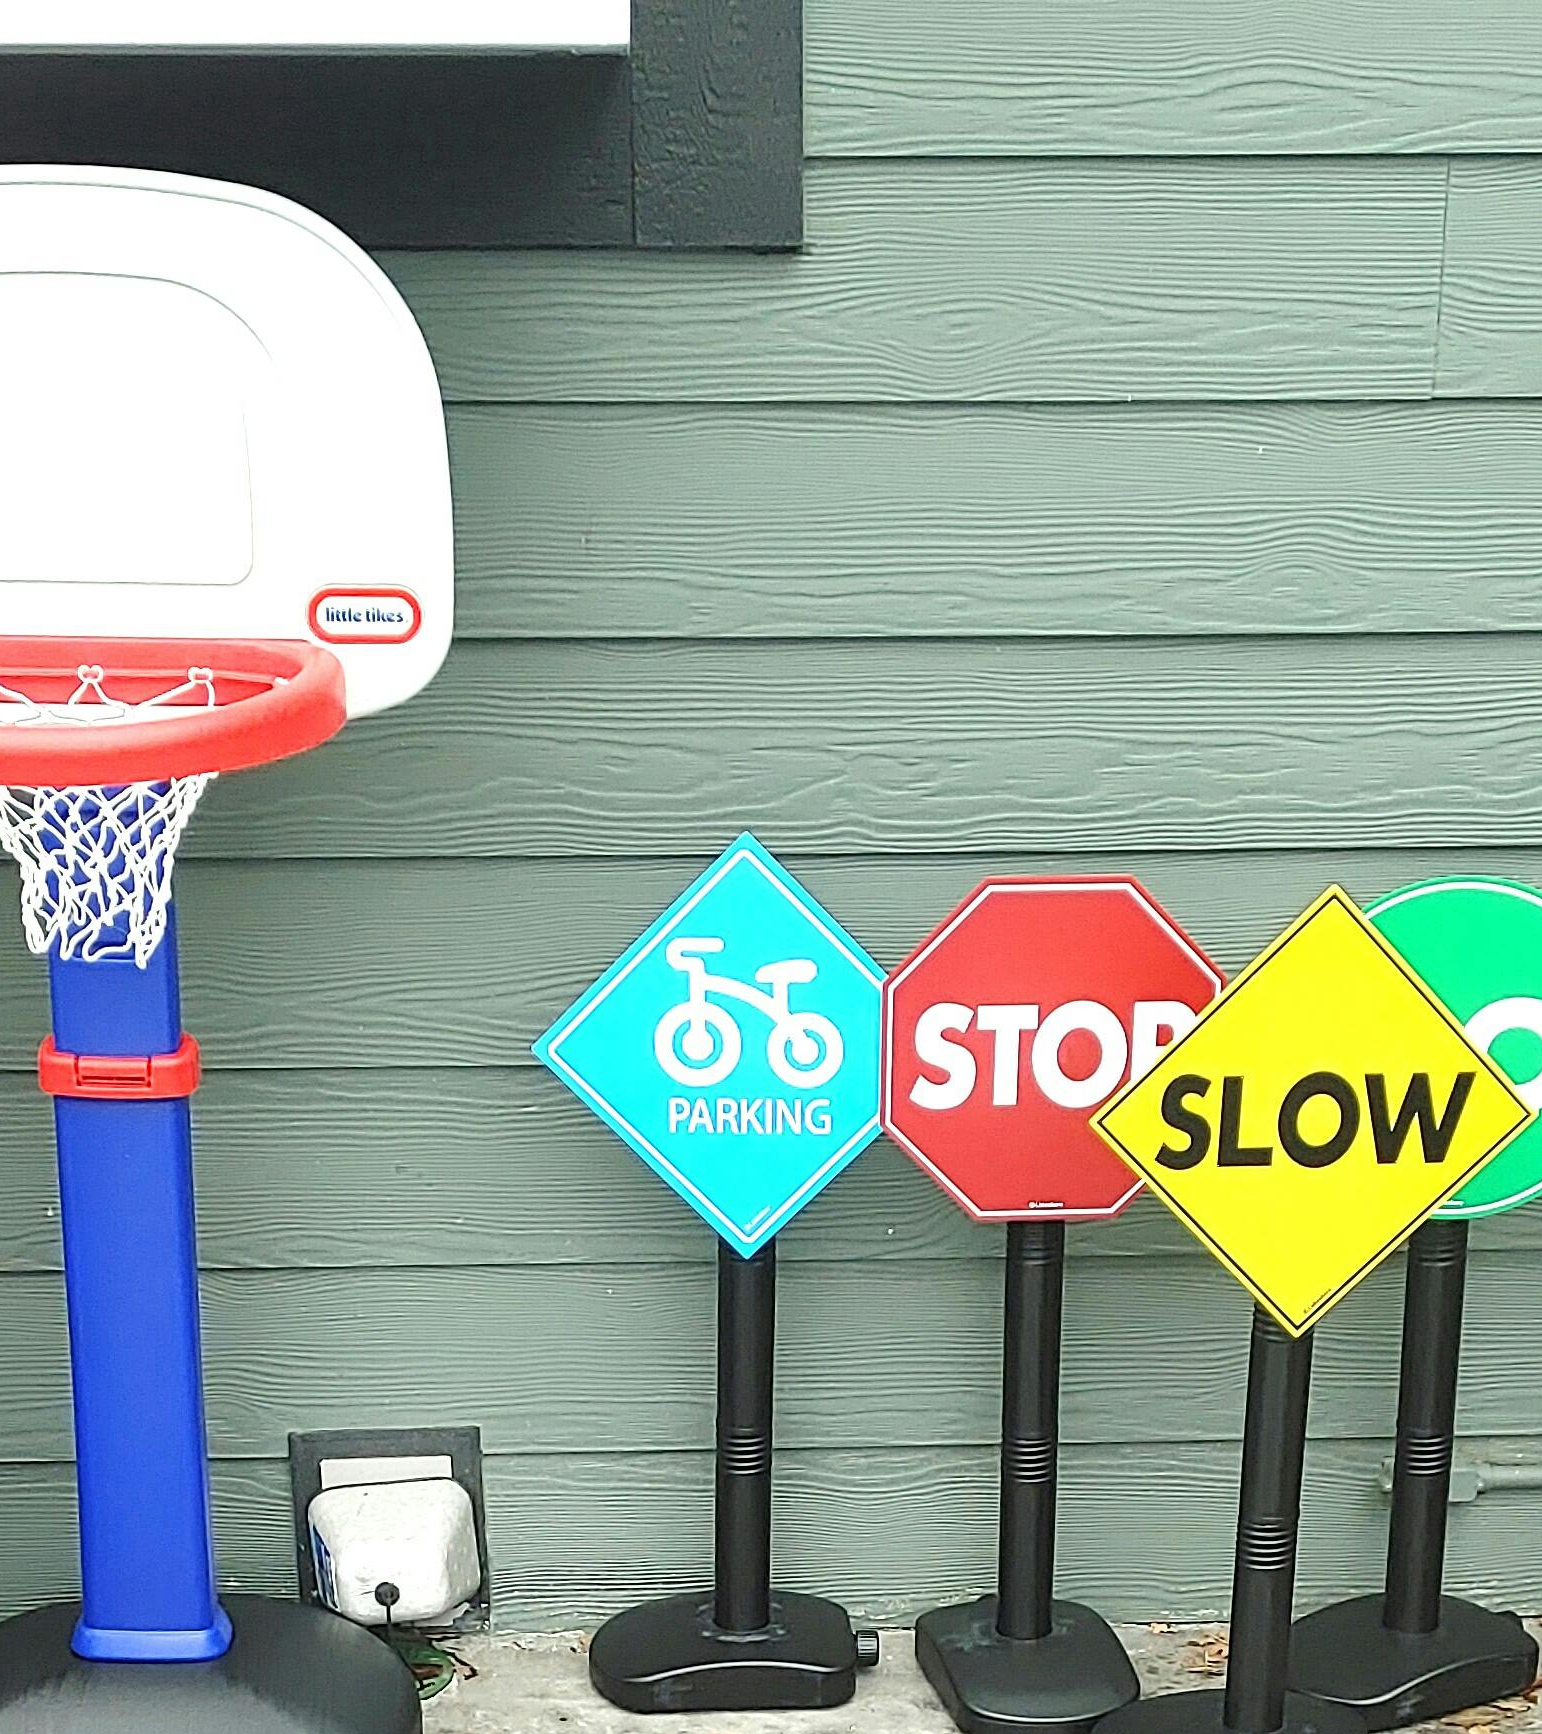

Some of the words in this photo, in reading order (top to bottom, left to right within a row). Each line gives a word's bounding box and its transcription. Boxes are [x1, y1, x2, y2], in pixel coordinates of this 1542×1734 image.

[325, 607, 362, 623] little
[365, 607, 404, 623] tikes
[908, 999, 1199, 1110] STOP
[667, 1096, 833, 1136] PARKING
[1154, 1070, 1476, 1172] SLOW
